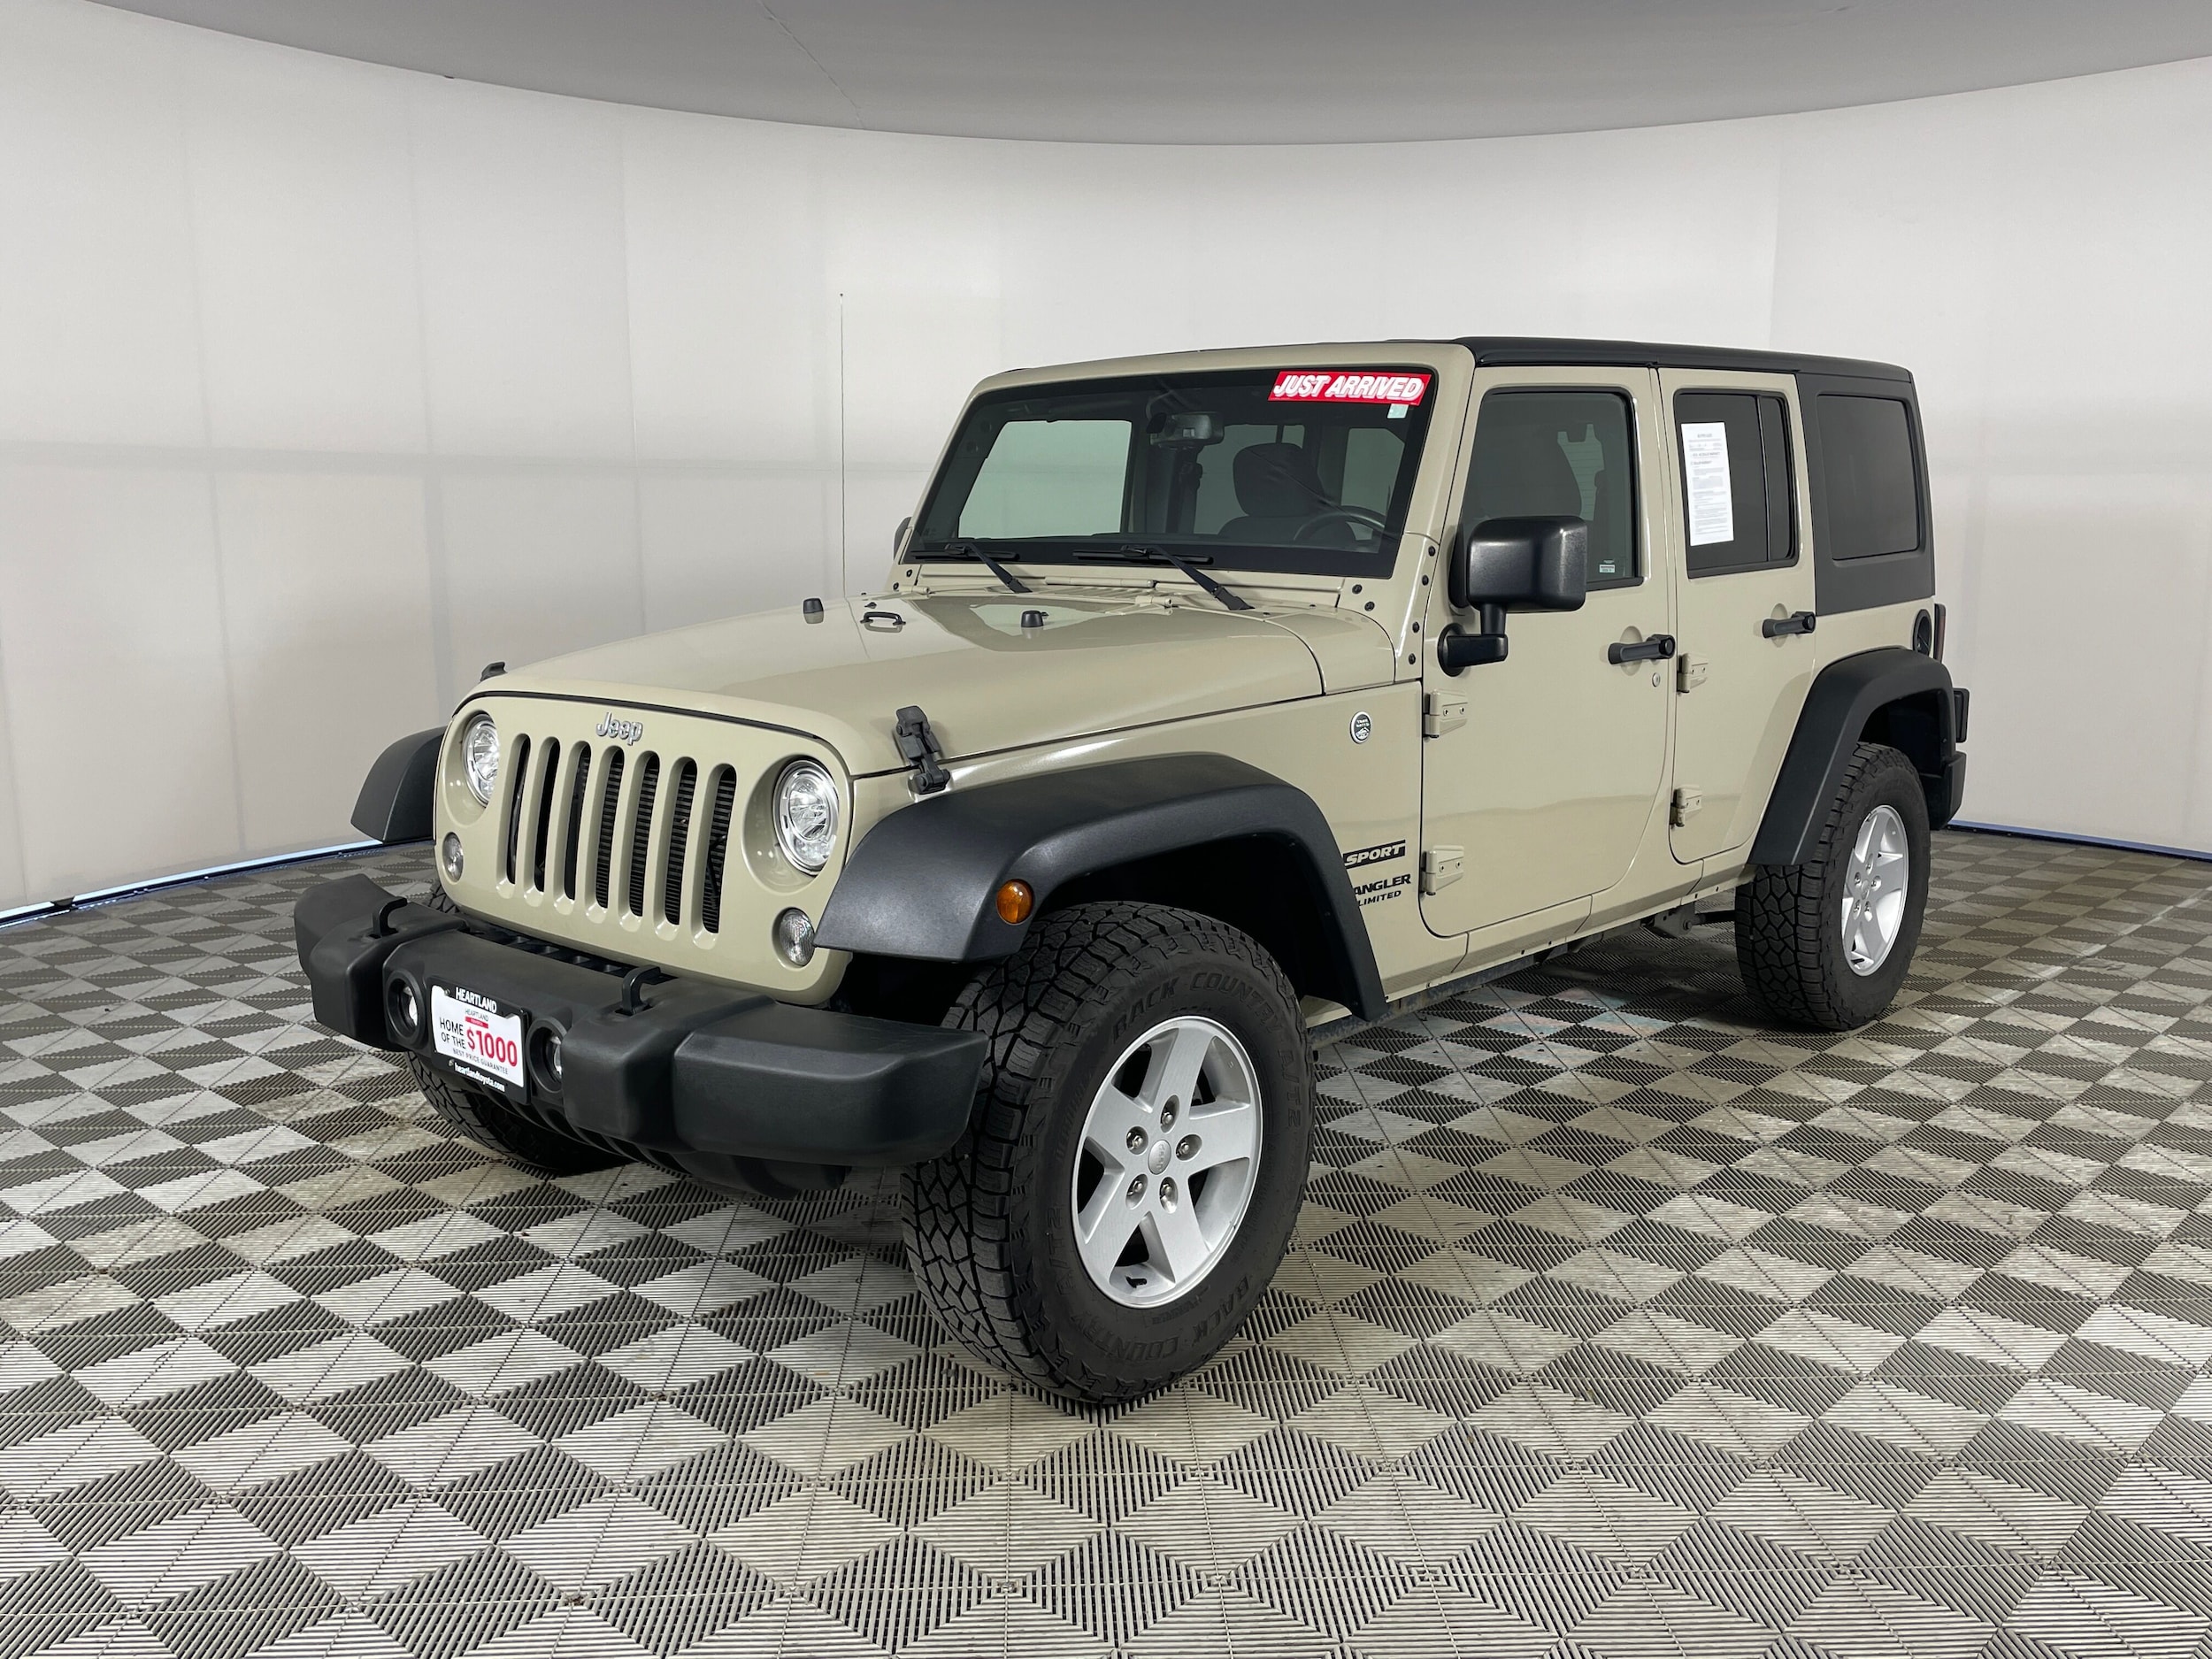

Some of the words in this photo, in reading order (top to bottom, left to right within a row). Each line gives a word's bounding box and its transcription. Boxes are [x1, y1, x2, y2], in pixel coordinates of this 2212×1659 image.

[1273, 375, 1331, 397] JUST
[1325, 376, 1425, 401] ARRIVED
[596, 711, 643, 746] Jeep
[1344, 843, 1405, 866] SPORT
[1354, 873, 1411, 895] ANGLER
[1358, 890, 1402, 907] LIMITED
[456, 987, 497, 1013] HEARTLAND
[465, 1008, 488, 1022] HEARTLAND
[439, 1017, 465, 1036] HOME
[441, 1032, 450, 1042] OF
[452, 1035, 466, 1049] THE
[466, 1027, 518, 1067] $1000
[454, 1062, 505, 1092] heartlandtoyota.com
[480, 1058, 509, 1075] GUARANTEE
